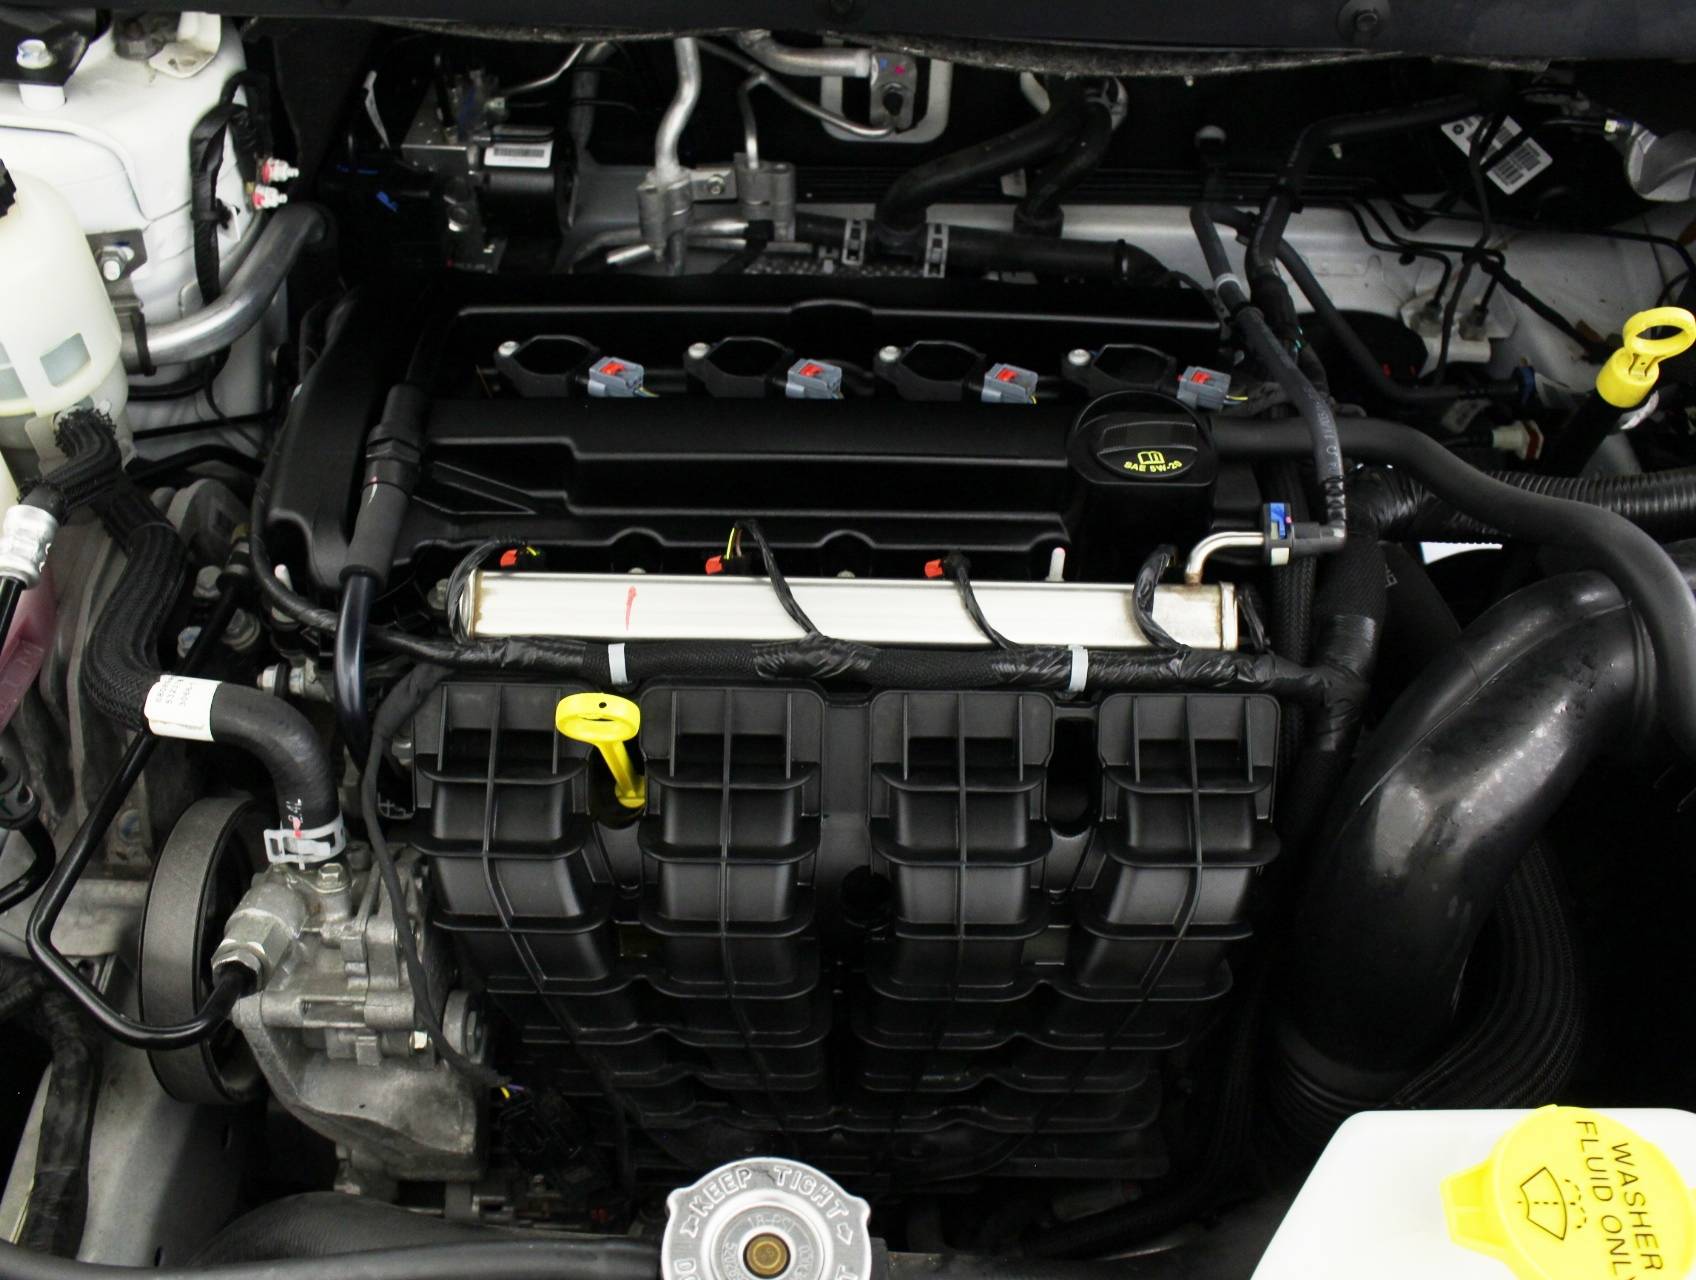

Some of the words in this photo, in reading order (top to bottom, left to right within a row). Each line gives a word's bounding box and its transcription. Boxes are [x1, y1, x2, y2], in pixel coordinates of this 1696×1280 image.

[1124, 461, 1146, 472] SAE
[689, 1167, 752, 1217] KEEP
[774, 1165, 849, 1218] TIGHT
[1575, 1121, 1614, 1202] FLUID
[1600, 1214, 1636, 1280] ONL
[1611, 1143, 1664, 1271] WASHER
